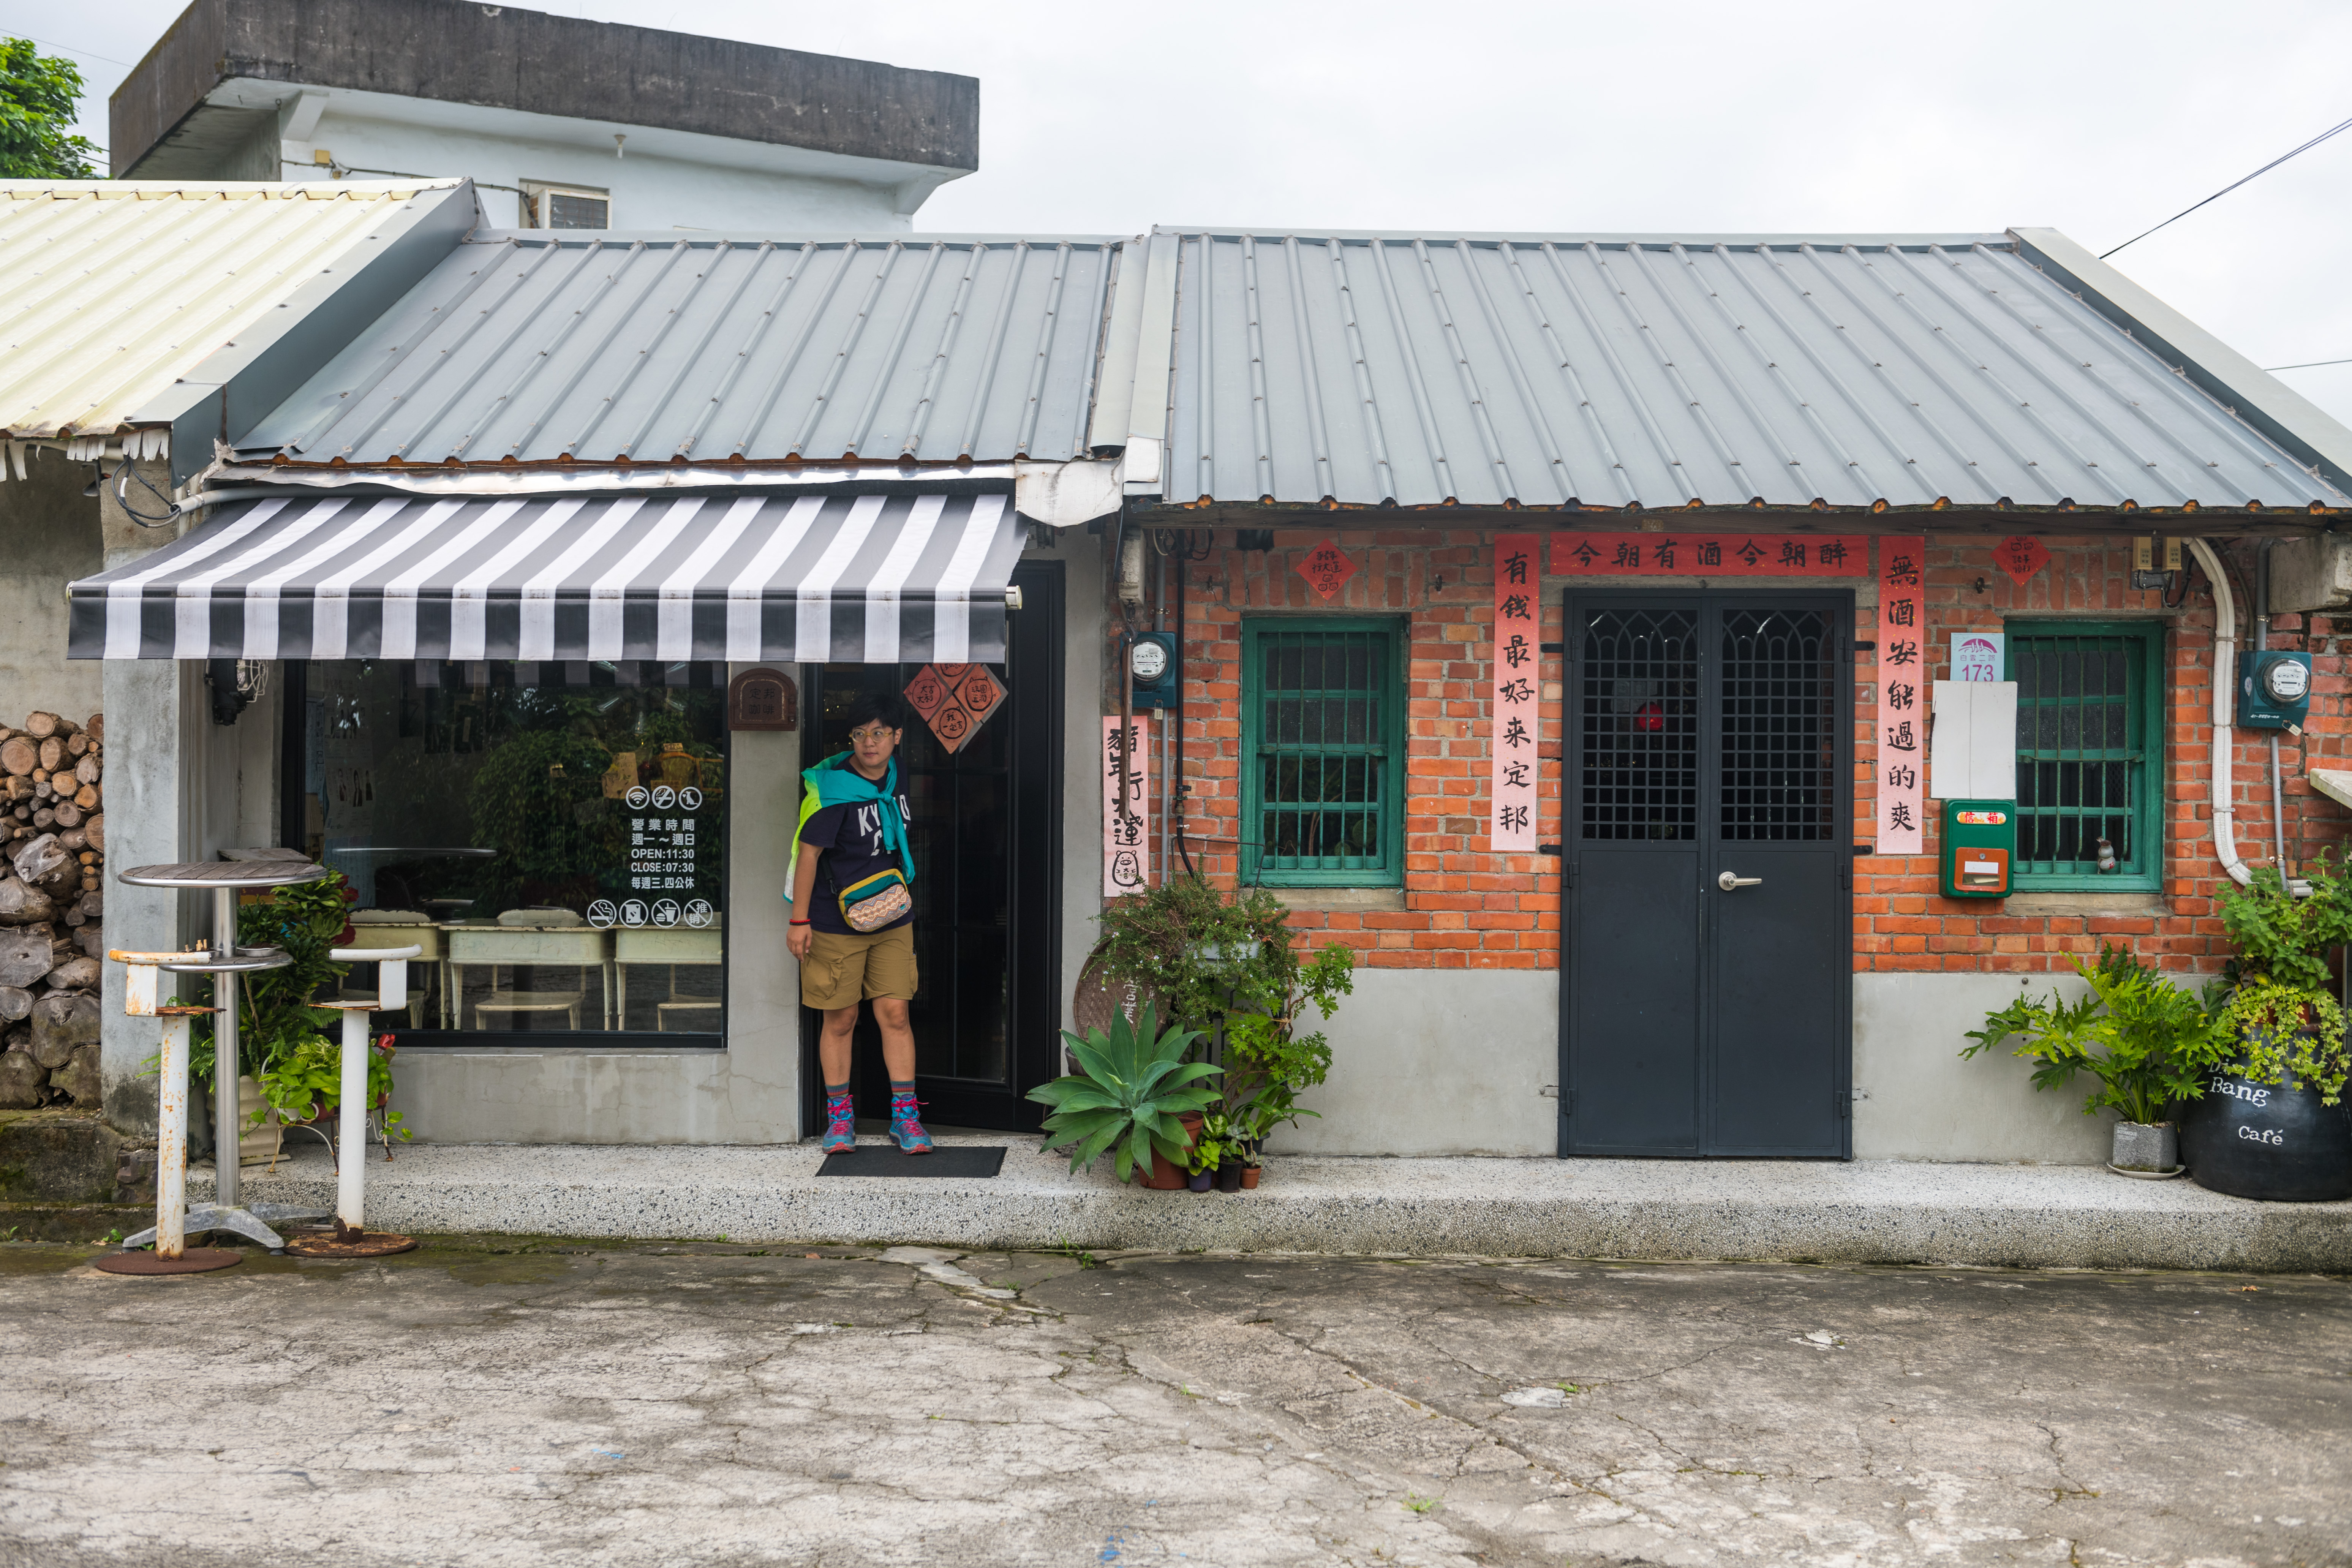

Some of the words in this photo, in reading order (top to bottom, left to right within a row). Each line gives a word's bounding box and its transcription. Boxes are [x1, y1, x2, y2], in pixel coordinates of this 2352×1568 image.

[1317, 550, 1337, 560] 豬年
[1570, 538, 1848, 569] 今朝有酒今朝醉
[1312, 561, 1342, 574] 行大運
[1962, 664, 1993, 681] 173
[749, 688, 775, 699] 定邦
[920, 685, 934, 694] 大吉
[1886, 555, 1919, 831] 無酒安能過的爽
[917, 694, 933, 703] 大利
[749, 704, 775, 714] 咖啡
[947, 711, 956, 721] 我
[943, 721, 962, 731] 一定吉
[858, 794, 911, 836] KYO
[1965, 812, 1998, 824] 信箱
[632, 819, 694, 831] 營業時間
[631, 849, 694, 858] OPEN:11:30
[631, 862, 694, 872] CLOSE:07:30
[631, 877, 694, 889] 每週三.四公休
[2210, 1076, 2271, 1108] Bang
[2238, 1125, 2283, 1145] Café
